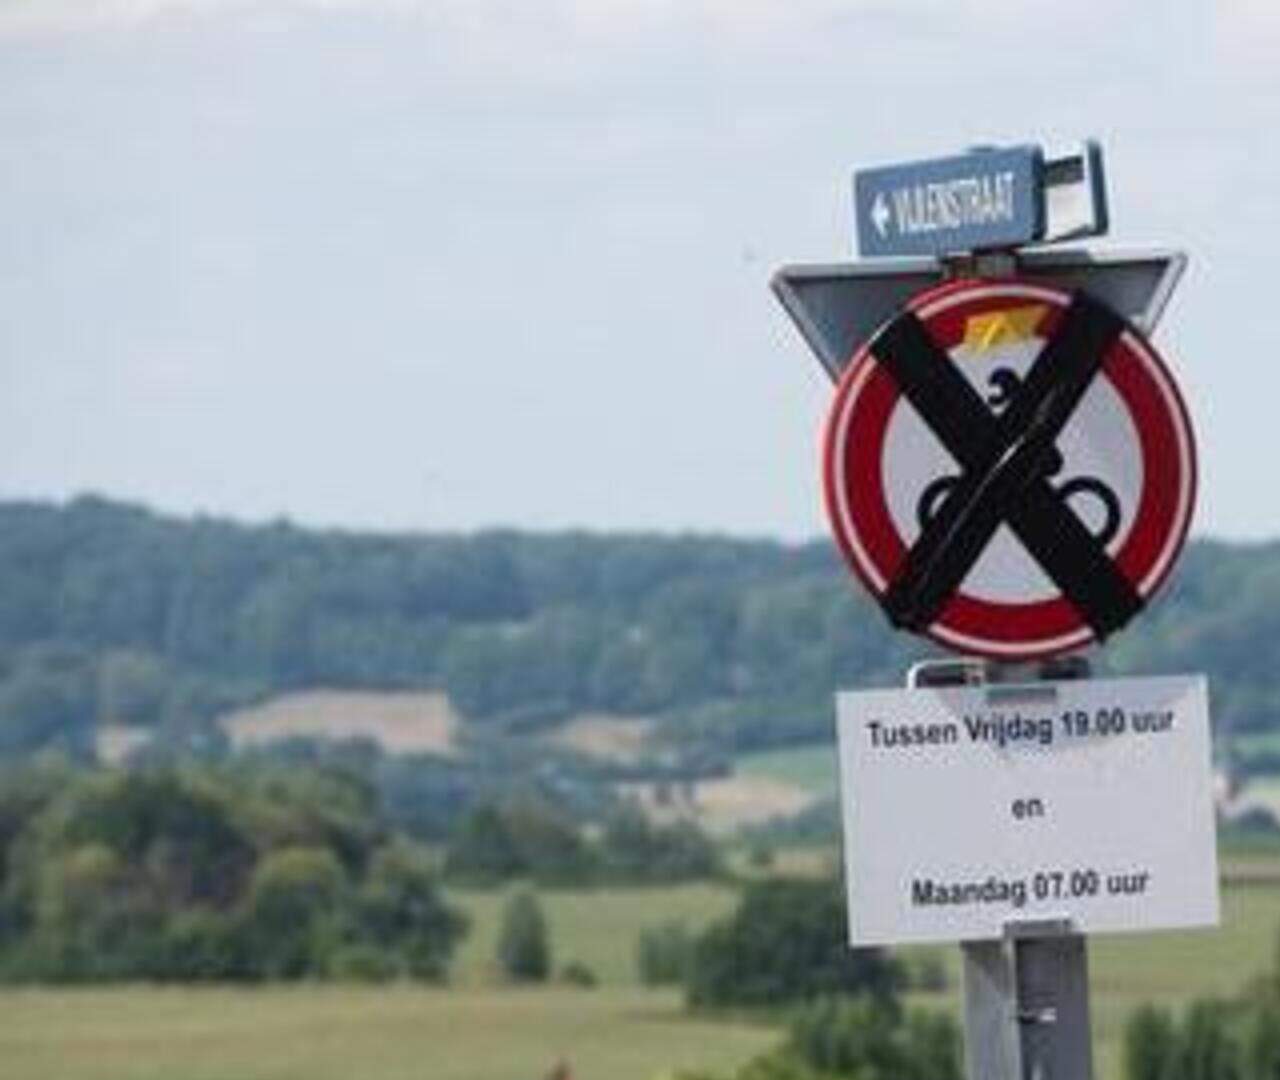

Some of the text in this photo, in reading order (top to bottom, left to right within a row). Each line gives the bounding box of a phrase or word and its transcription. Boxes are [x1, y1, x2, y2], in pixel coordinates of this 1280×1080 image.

[866, 708, 1174, 748] Tussen Vrijdag 19.00 uur
[1012, 800, 1045, 818] en
[911, 872, 1150, 907] Maandag 07.00 uur
